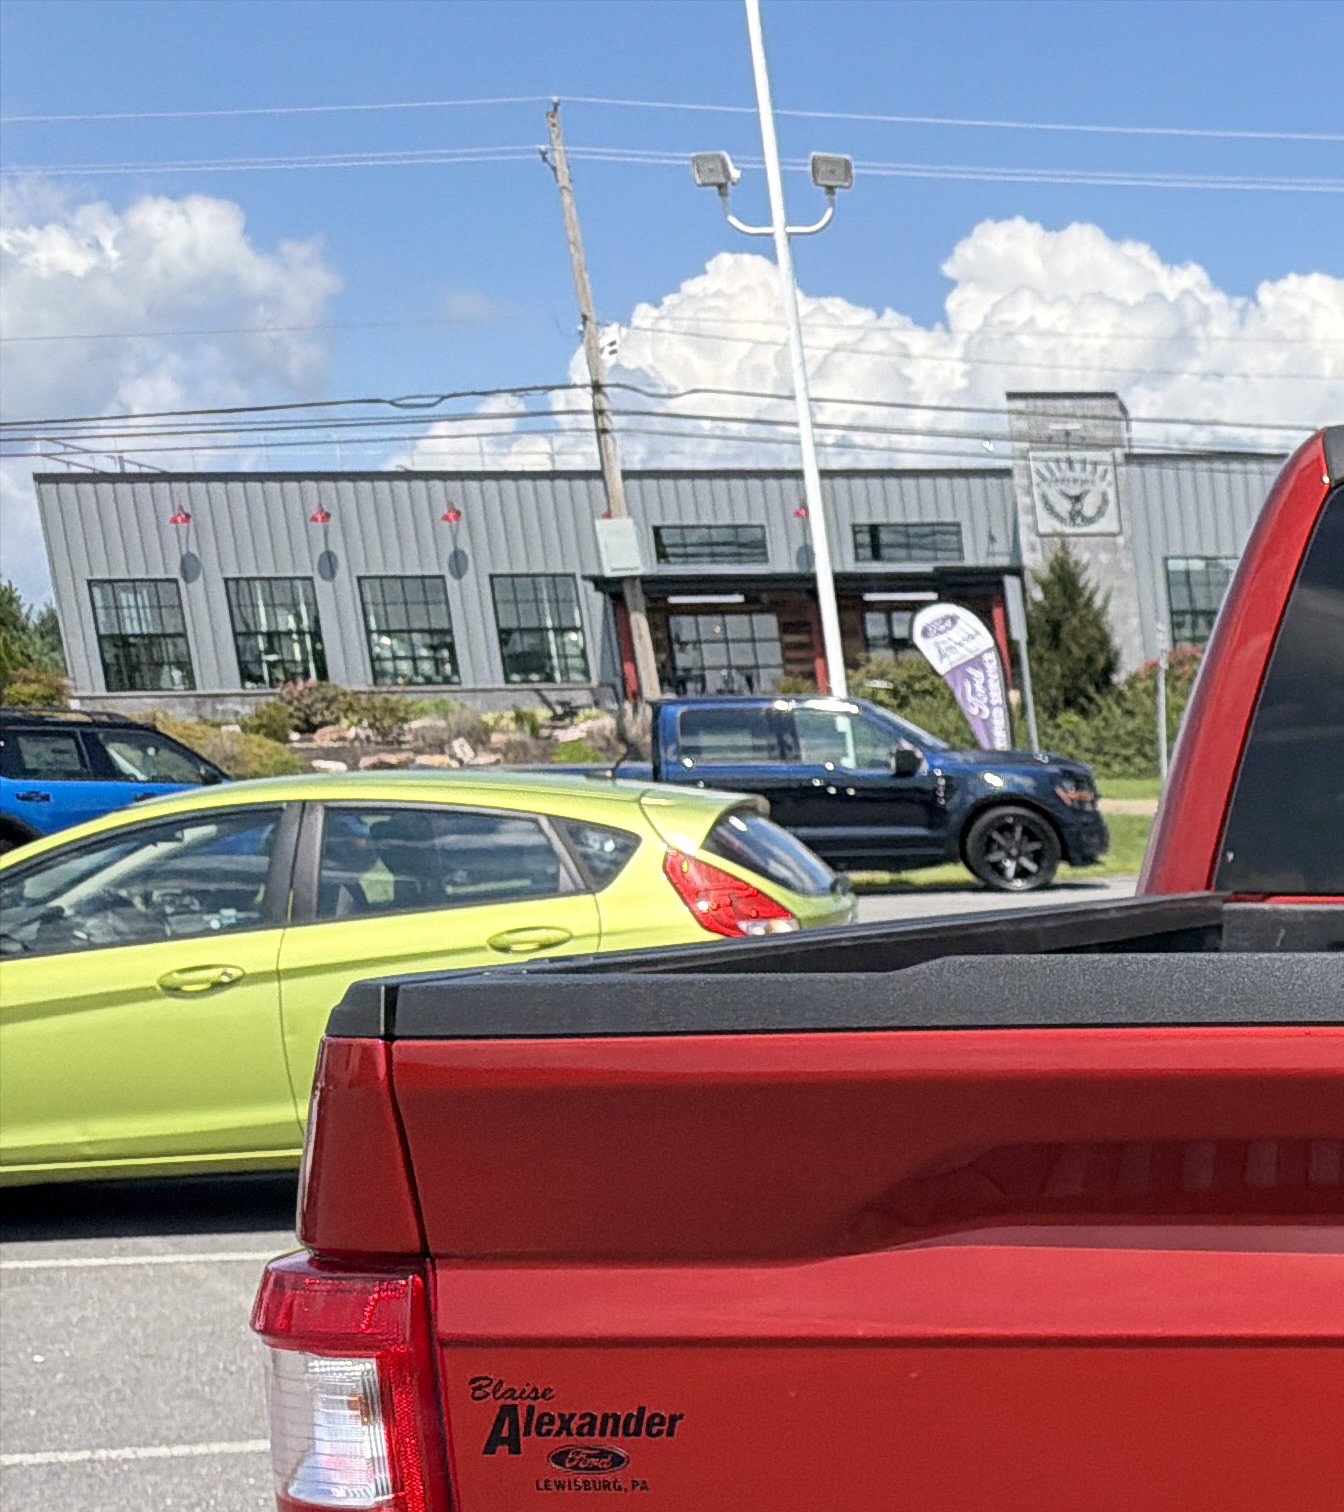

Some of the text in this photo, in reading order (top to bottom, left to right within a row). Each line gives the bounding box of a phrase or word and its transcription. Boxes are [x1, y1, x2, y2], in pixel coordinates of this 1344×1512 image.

[468, 1376, 555, 1401] Blaise
[482, 1404, 685, 1455] Alexander
[564, 1448, 613, 1470] Ford
[536, 1479, 650, 1493] LEWISBURG, PA
